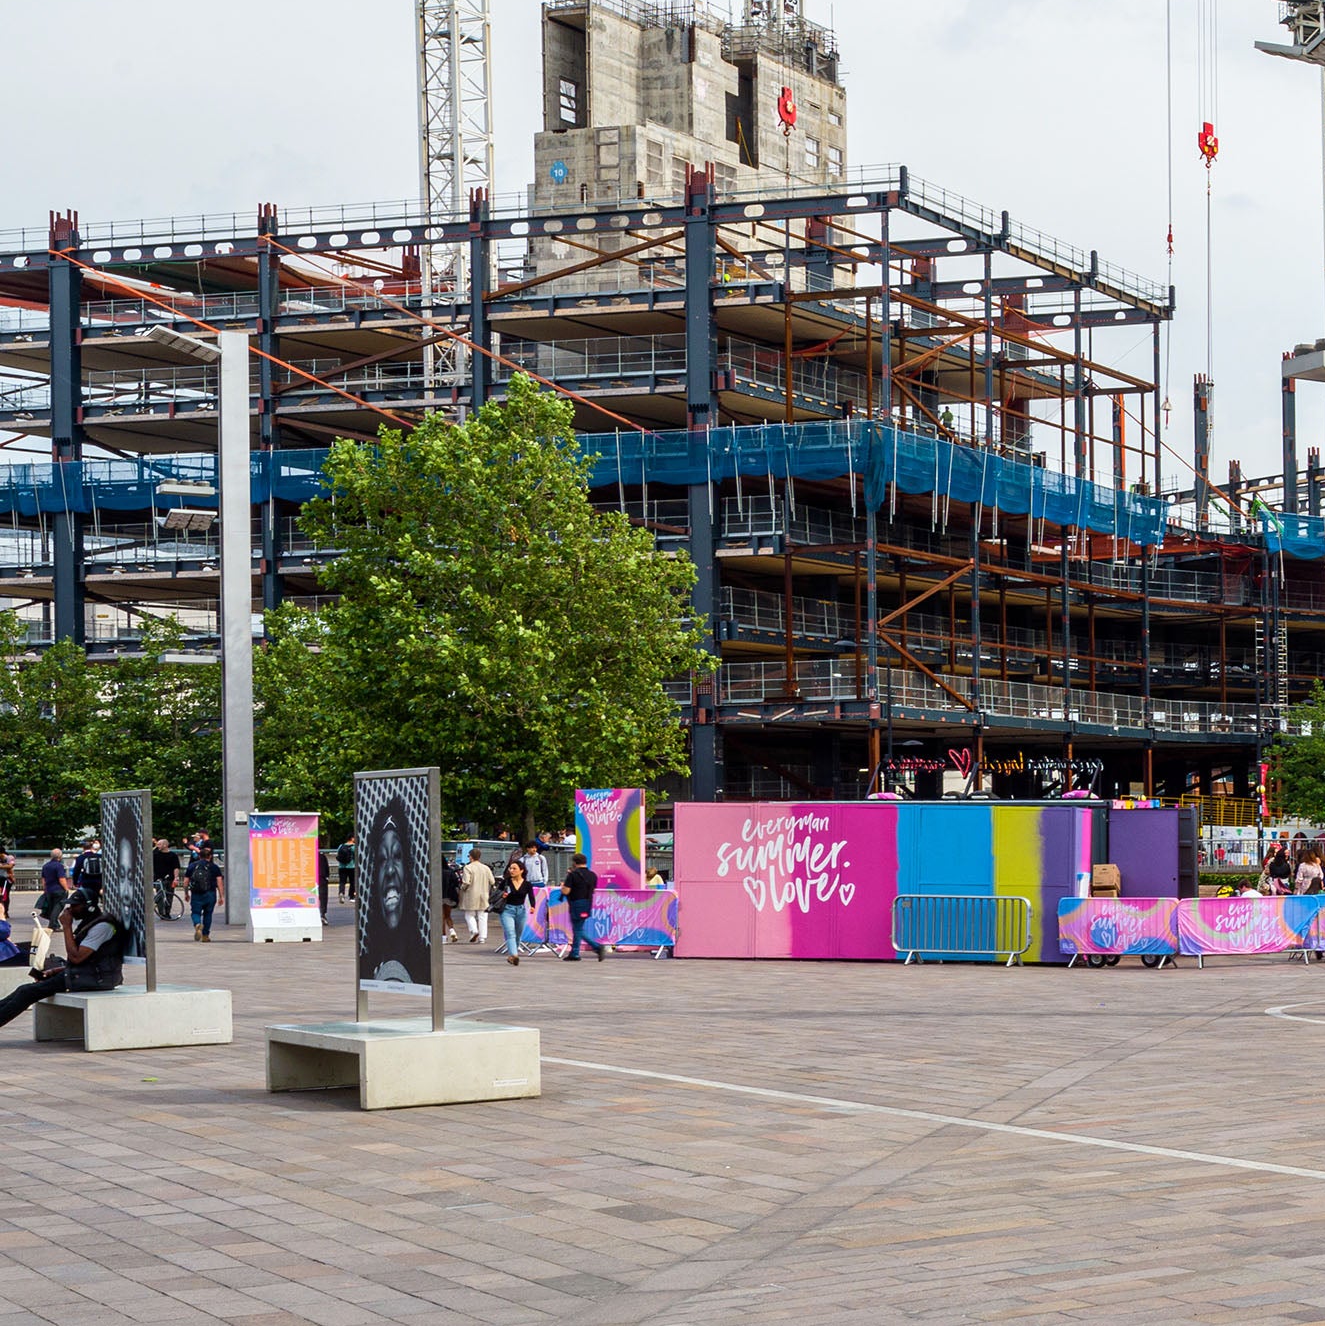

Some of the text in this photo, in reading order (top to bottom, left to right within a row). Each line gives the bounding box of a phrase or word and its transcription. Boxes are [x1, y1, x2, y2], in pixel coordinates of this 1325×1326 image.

[553, 169, 564, 177] 10
[742, 812, 829, 845] everyman
[717, 834, 851, 878] summer.
[769, 865, 840, 913] love
